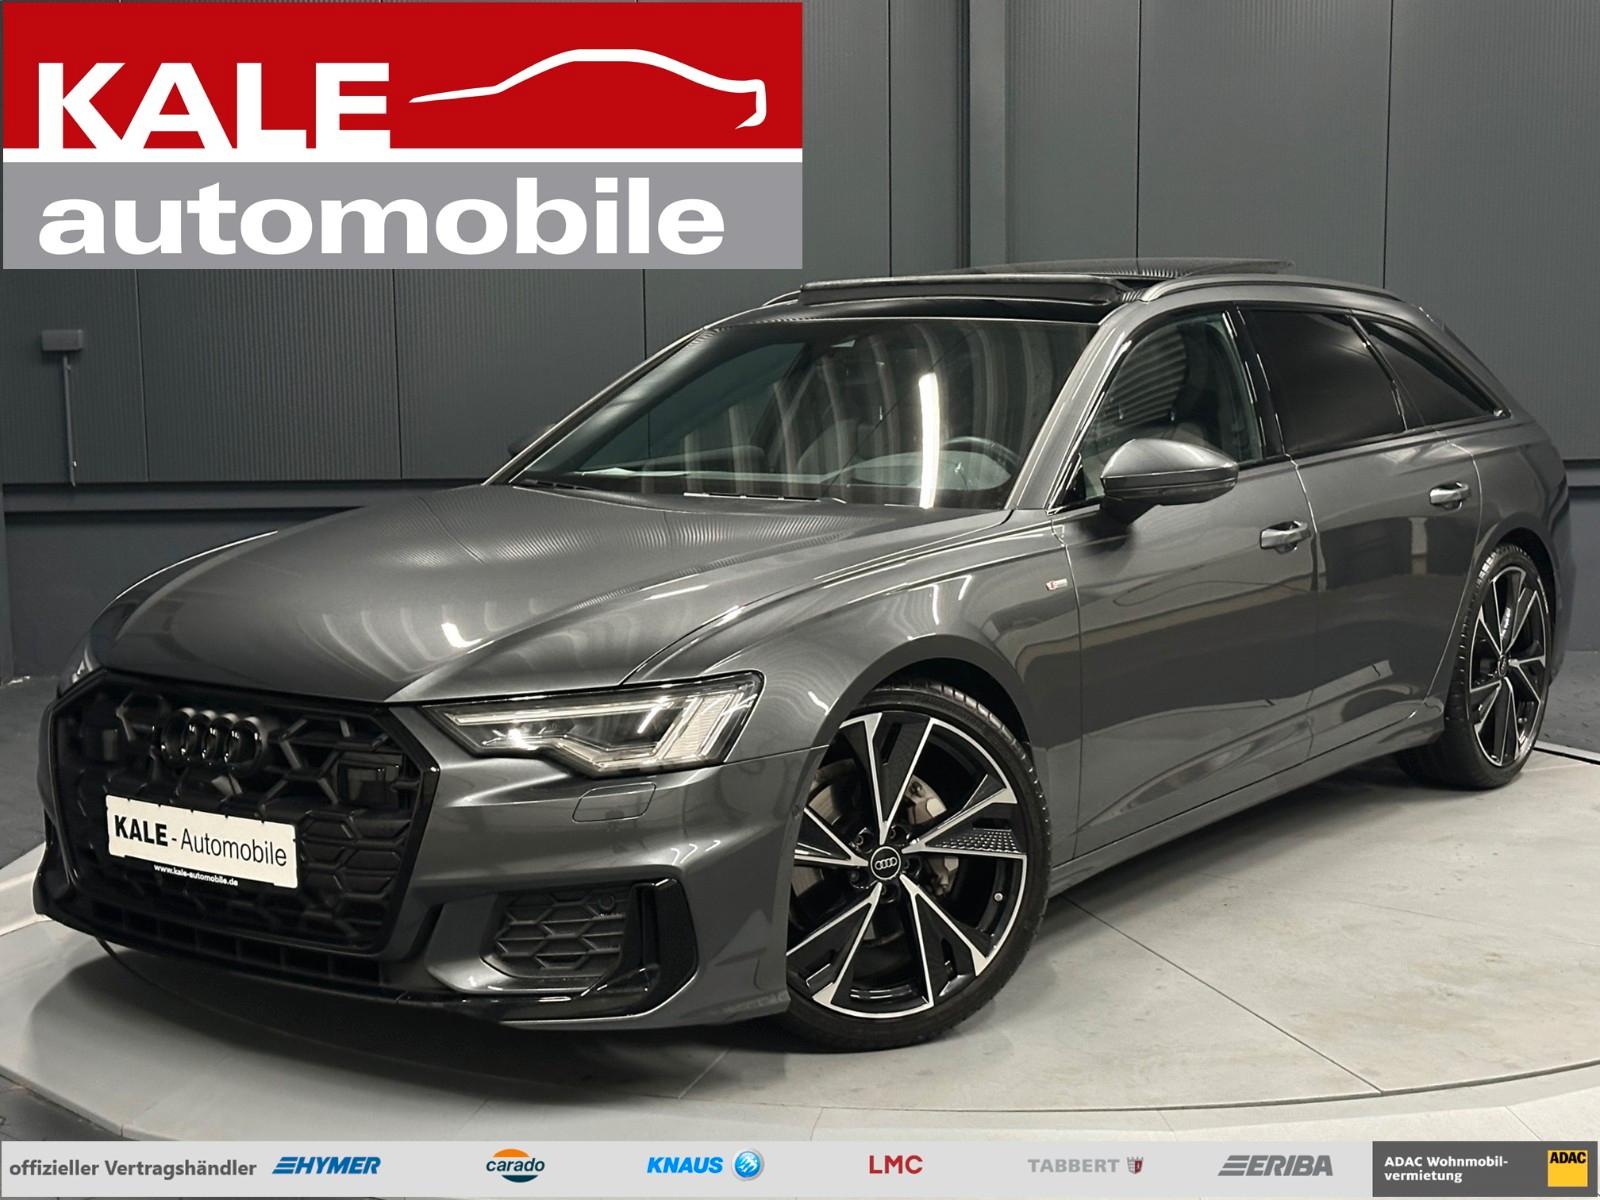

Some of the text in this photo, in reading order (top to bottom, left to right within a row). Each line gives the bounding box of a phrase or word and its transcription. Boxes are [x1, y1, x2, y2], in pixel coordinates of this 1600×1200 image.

[114, 815, 169, 847] KALE
[181, 828, 287, 867] Automobile
[153, 864, 239, 887] www.kale-automobile.de
